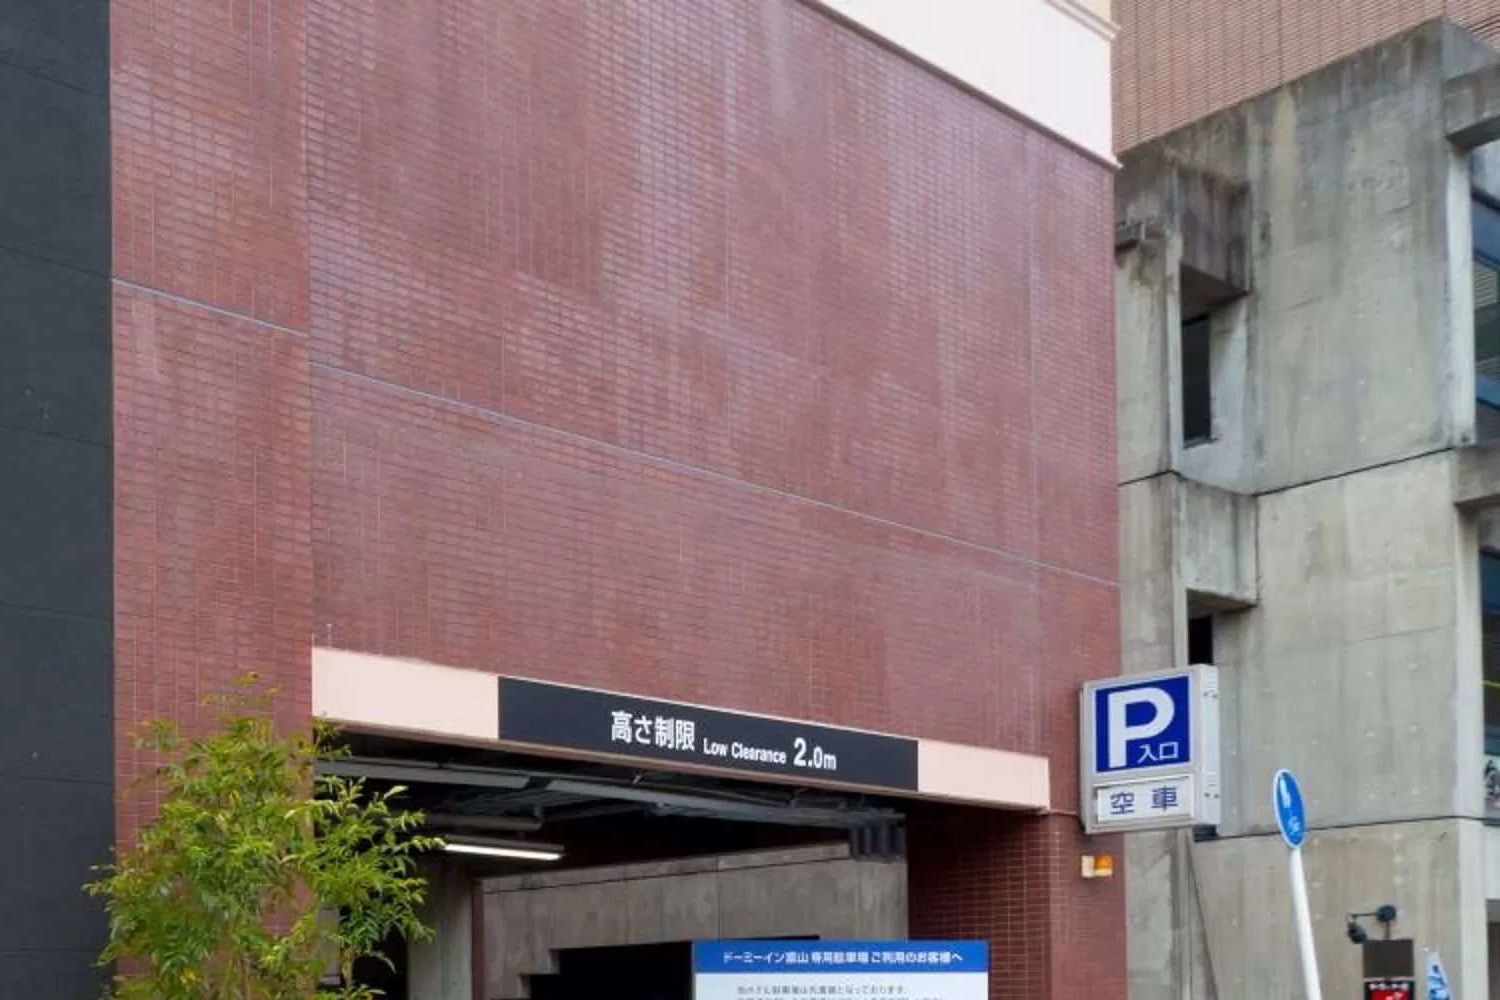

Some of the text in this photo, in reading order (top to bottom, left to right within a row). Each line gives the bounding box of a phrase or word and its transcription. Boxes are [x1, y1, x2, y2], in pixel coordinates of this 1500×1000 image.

[610, 709, 837, 771] 高さ制限 Low Clearance 2.0m
[1107, 686, 1175, 769] P
[1137, 741, 1180, 764] 入口
